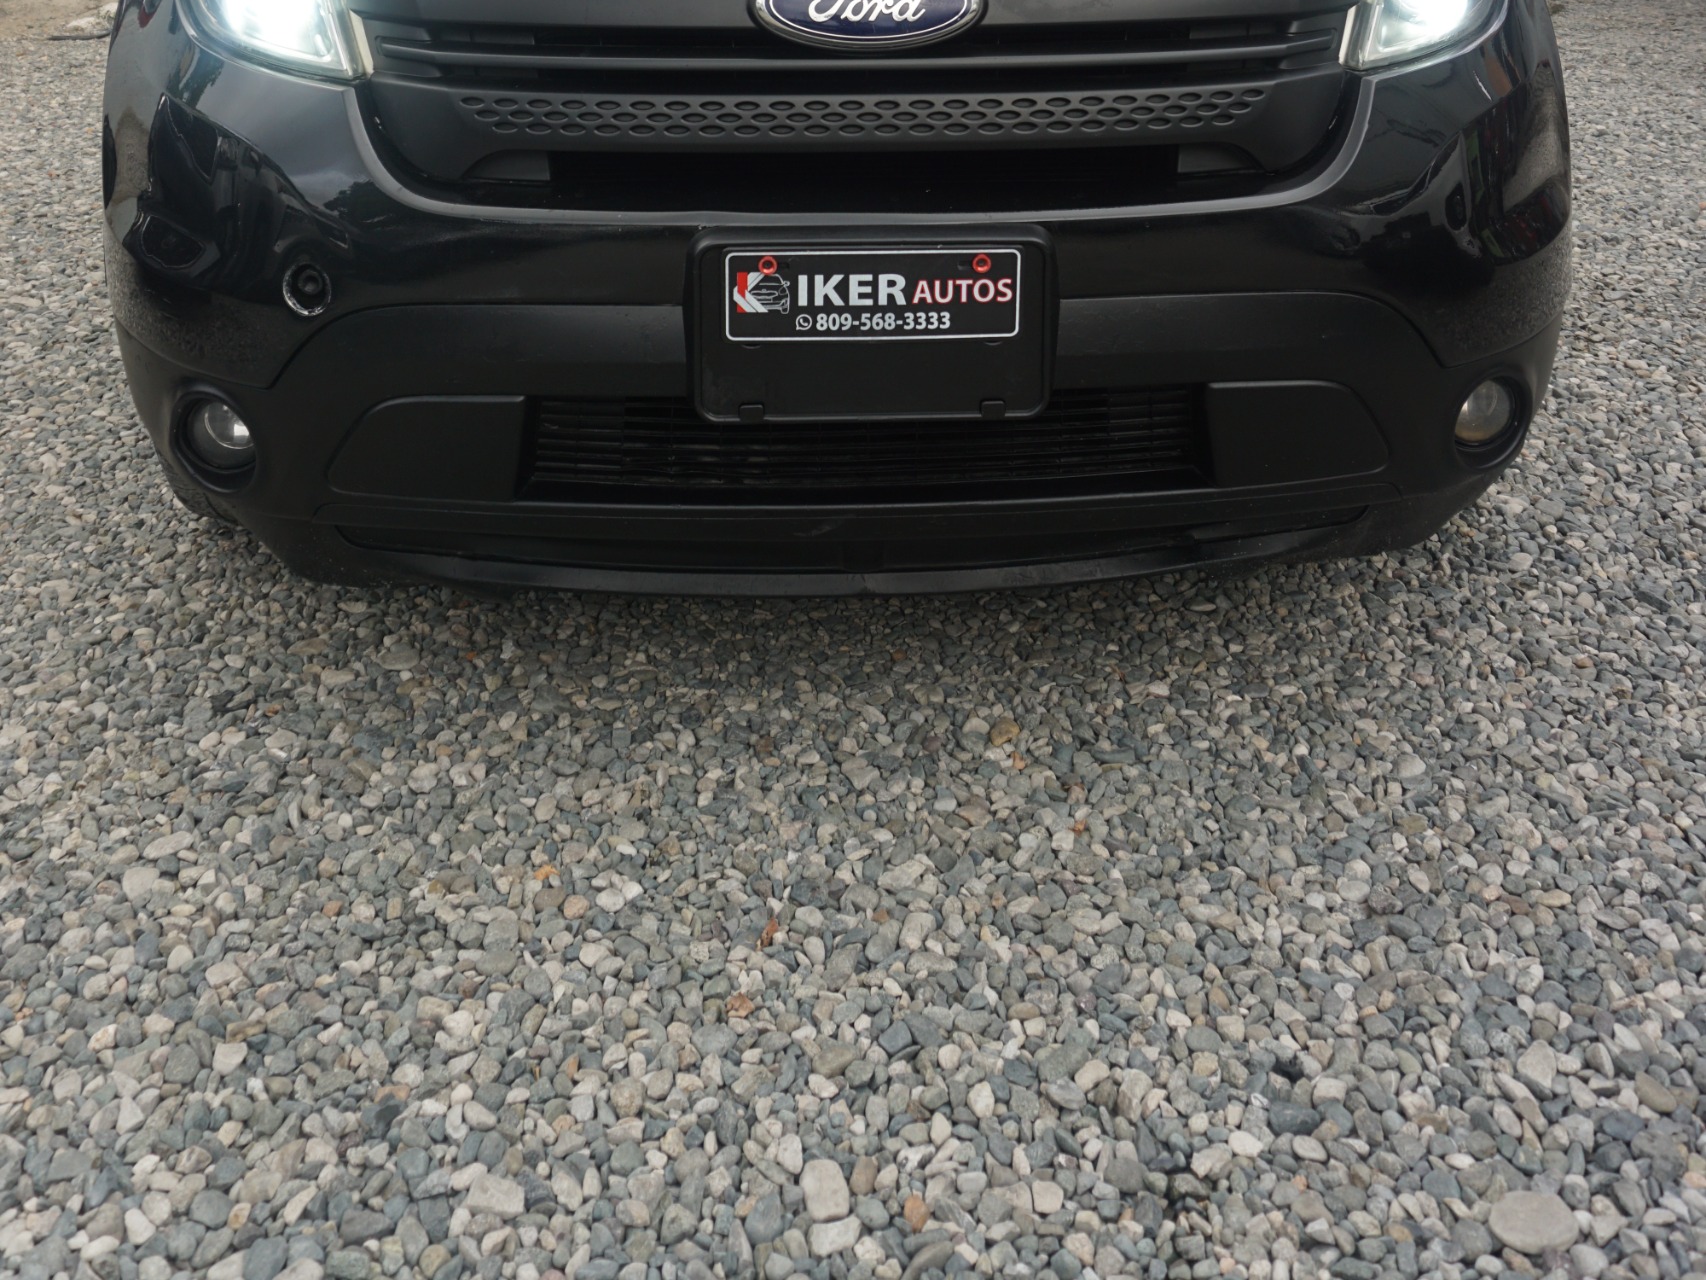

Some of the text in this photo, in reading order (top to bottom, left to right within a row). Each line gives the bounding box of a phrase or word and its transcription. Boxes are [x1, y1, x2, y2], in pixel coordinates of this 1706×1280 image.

[798, 273, 1014, 308] IKER AUTOS
[815, 311, 952, 332] 809-568-3333
